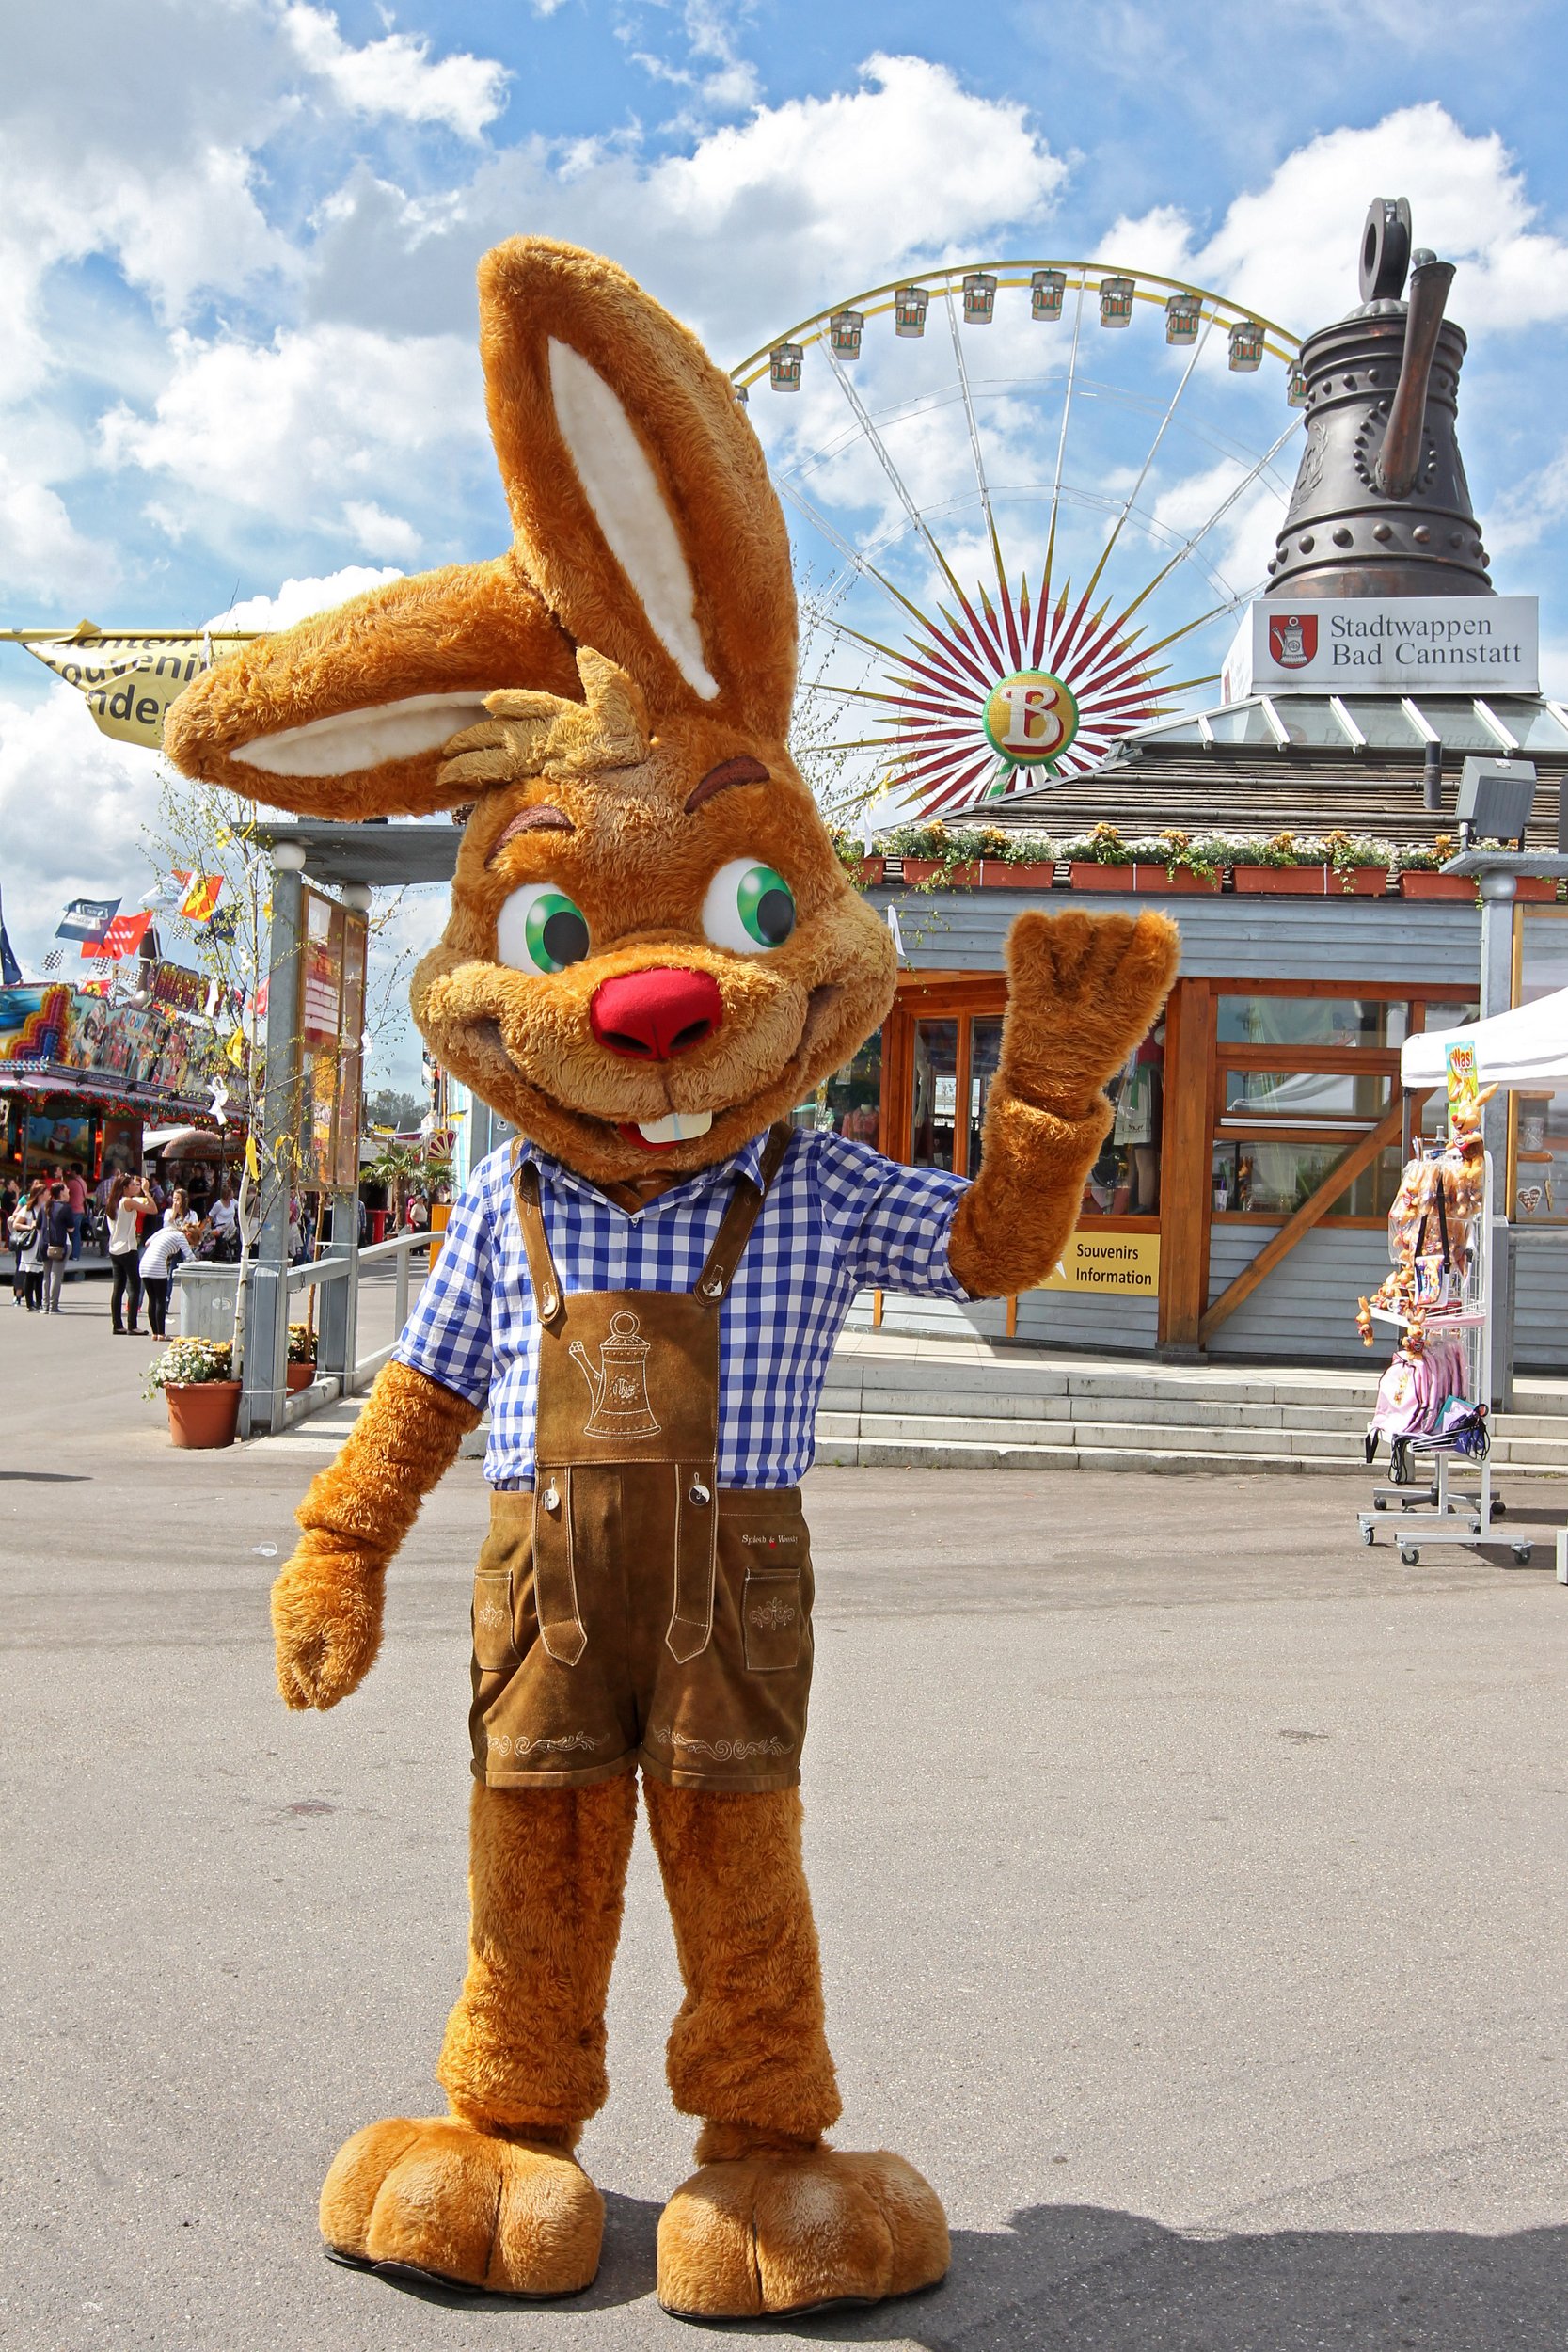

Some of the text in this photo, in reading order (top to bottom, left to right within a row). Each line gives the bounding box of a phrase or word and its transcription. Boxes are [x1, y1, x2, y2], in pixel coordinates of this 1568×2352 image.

[1330, 614, 1493, 642] Stadtwappen
[1331, 642, 1522, 666] Bad Cannstatt
[1000, 685, 1064, 755] B
[1076, 1243, 1139, 1260] Souvenirs
[1076, 1267, 1152, 1285] Information
